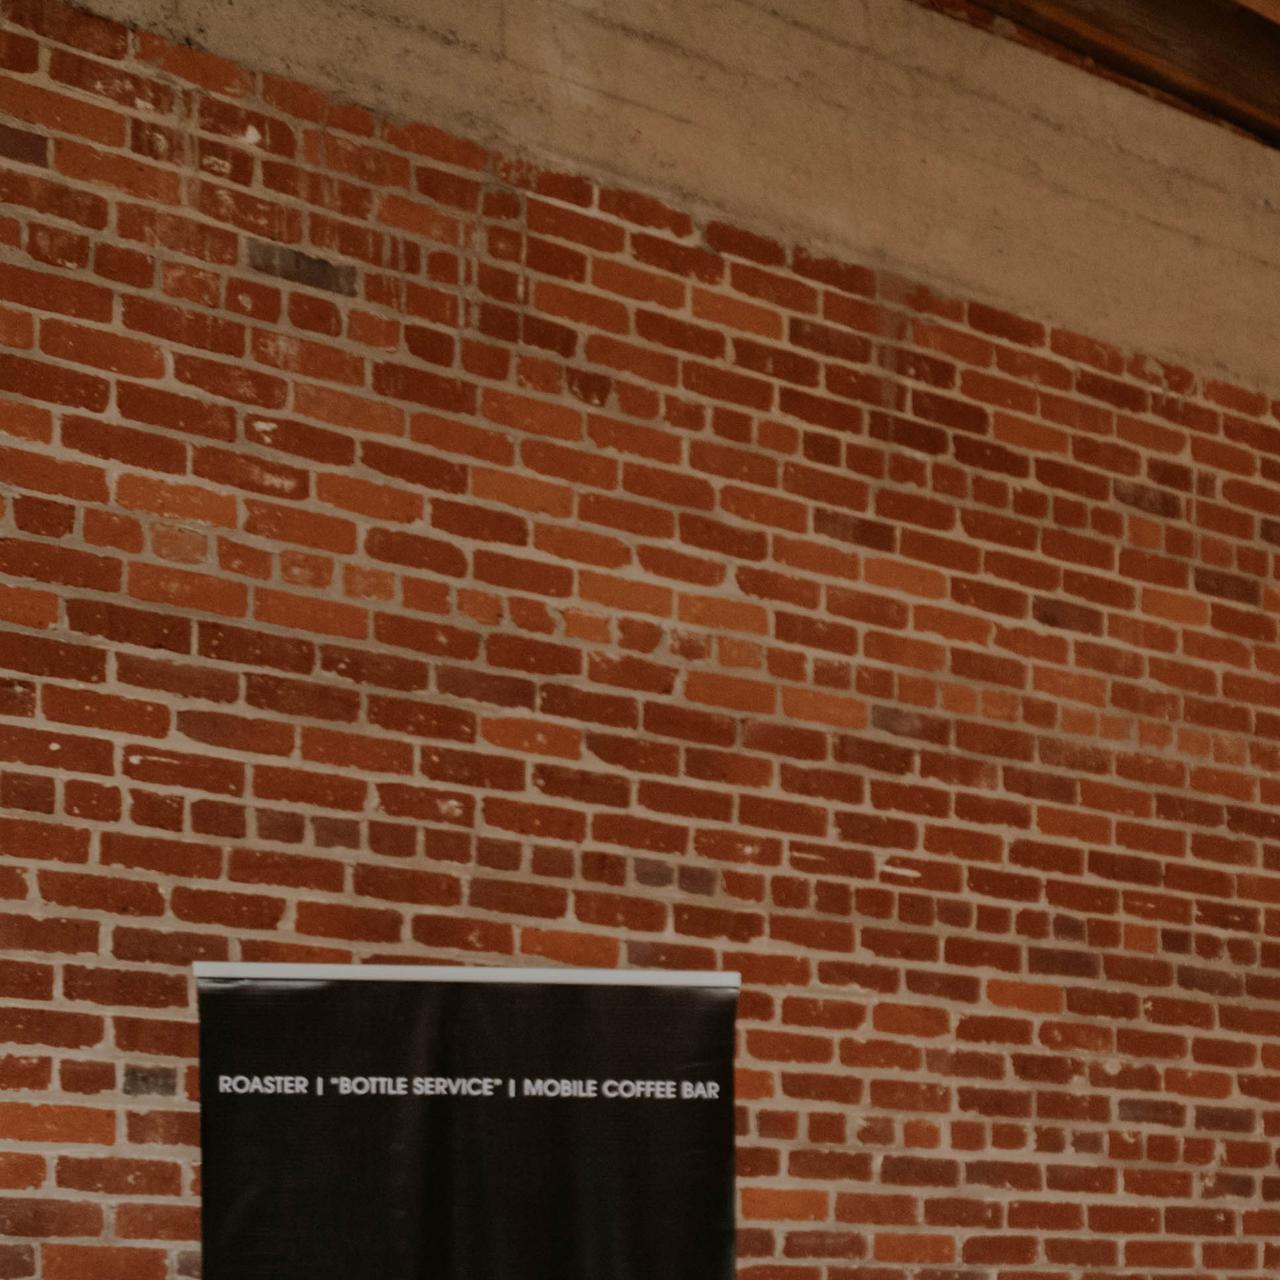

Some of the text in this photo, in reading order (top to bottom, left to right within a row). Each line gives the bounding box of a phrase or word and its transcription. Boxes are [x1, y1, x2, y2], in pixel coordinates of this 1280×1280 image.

[218, 1075, 309, 1095] ROASTER
[522, 1078, 598, 1098] MOBILE
[601, 1079, 677, 1099] COFFEE
[680, 1080, 720, 1100] BAR
